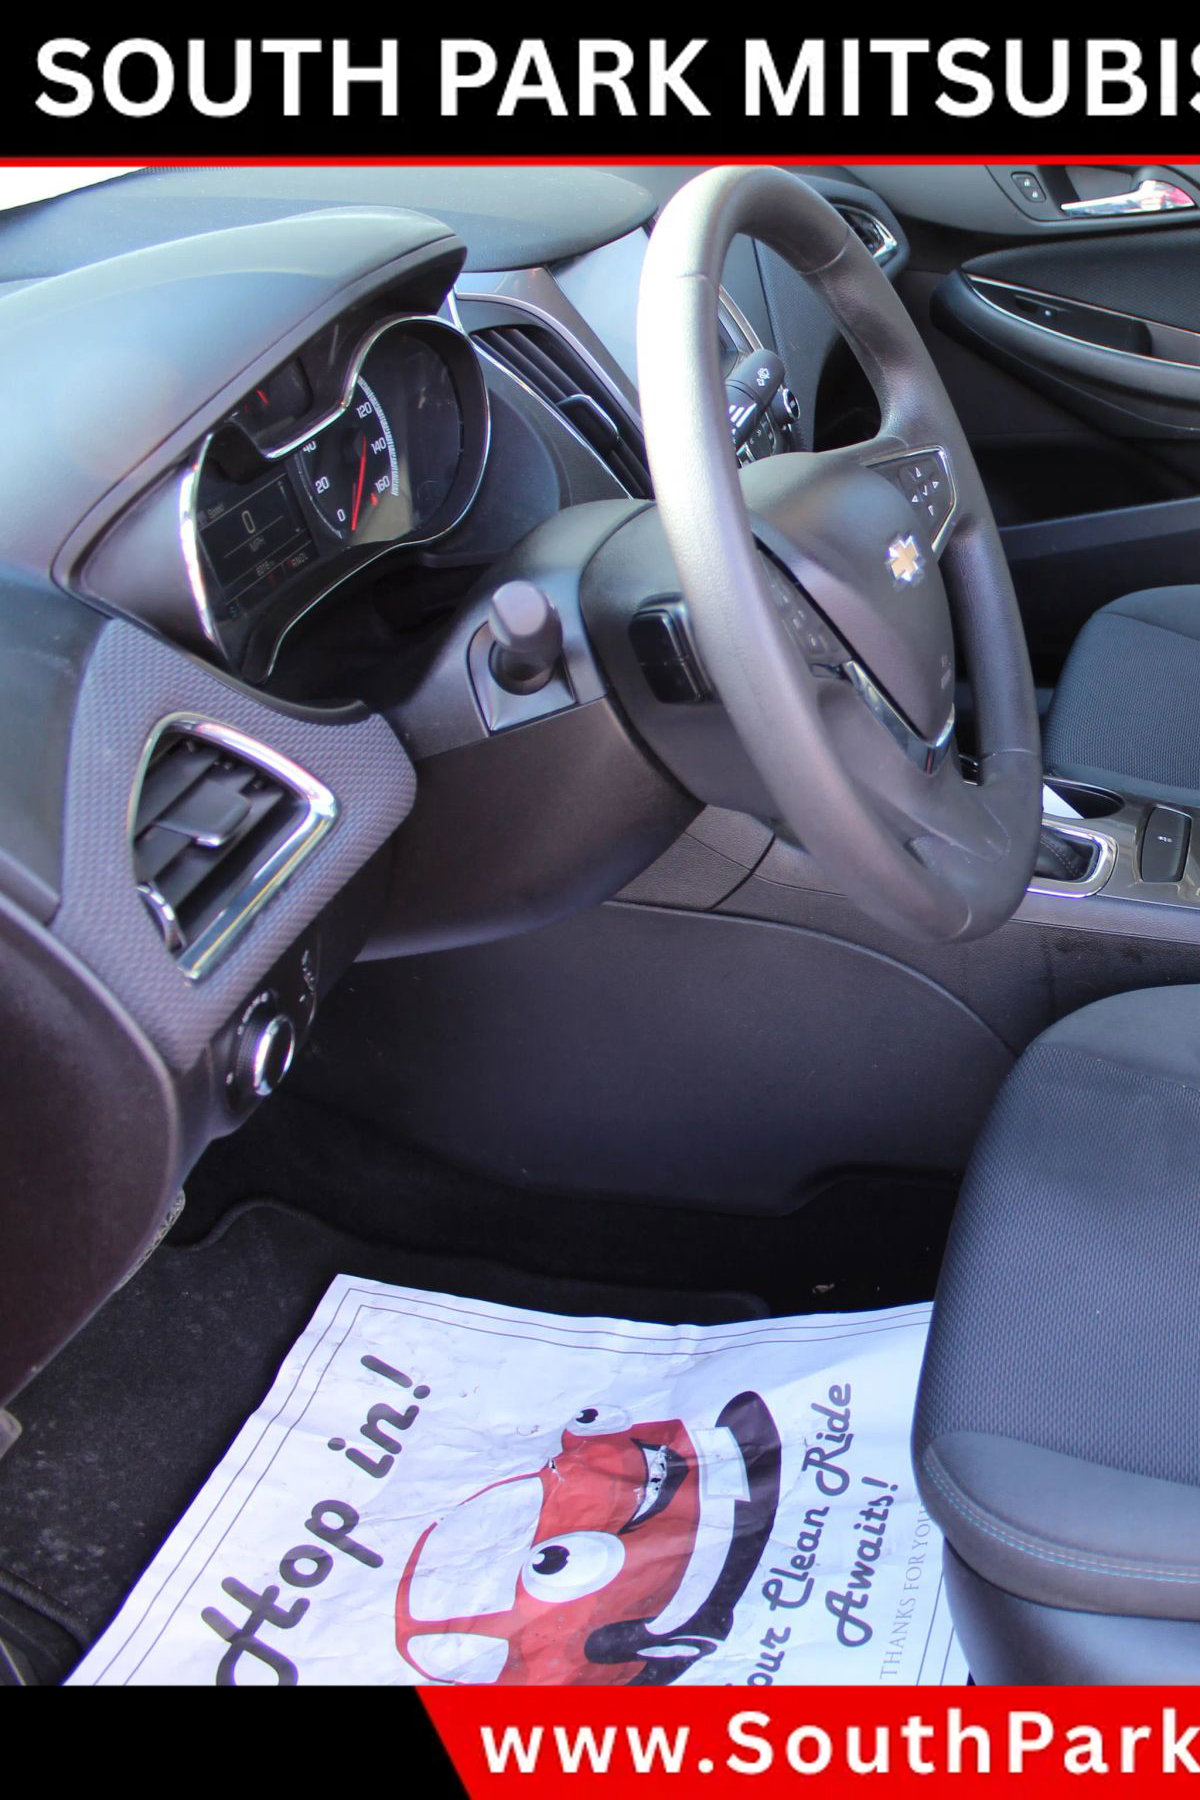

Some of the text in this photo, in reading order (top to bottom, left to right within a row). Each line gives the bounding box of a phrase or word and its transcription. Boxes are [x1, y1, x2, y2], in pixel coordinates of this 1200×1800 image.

[357, 402, 372, 418] 120
[371, 437, 386, 454] 140
[315, 476, 329, 493] 20
[374, 475, 390, 492] 160
[336, 508, 345, 522] 0
[201, 1355, 431, 1686] Hop in!
[745, 1383, 854, 1686] our Clean Ride
[825, 1476, 898, 1647] Awaits!
[880, 1596, 916, 1679] THANKS
[904, 1554, 928, 1592] FOR
